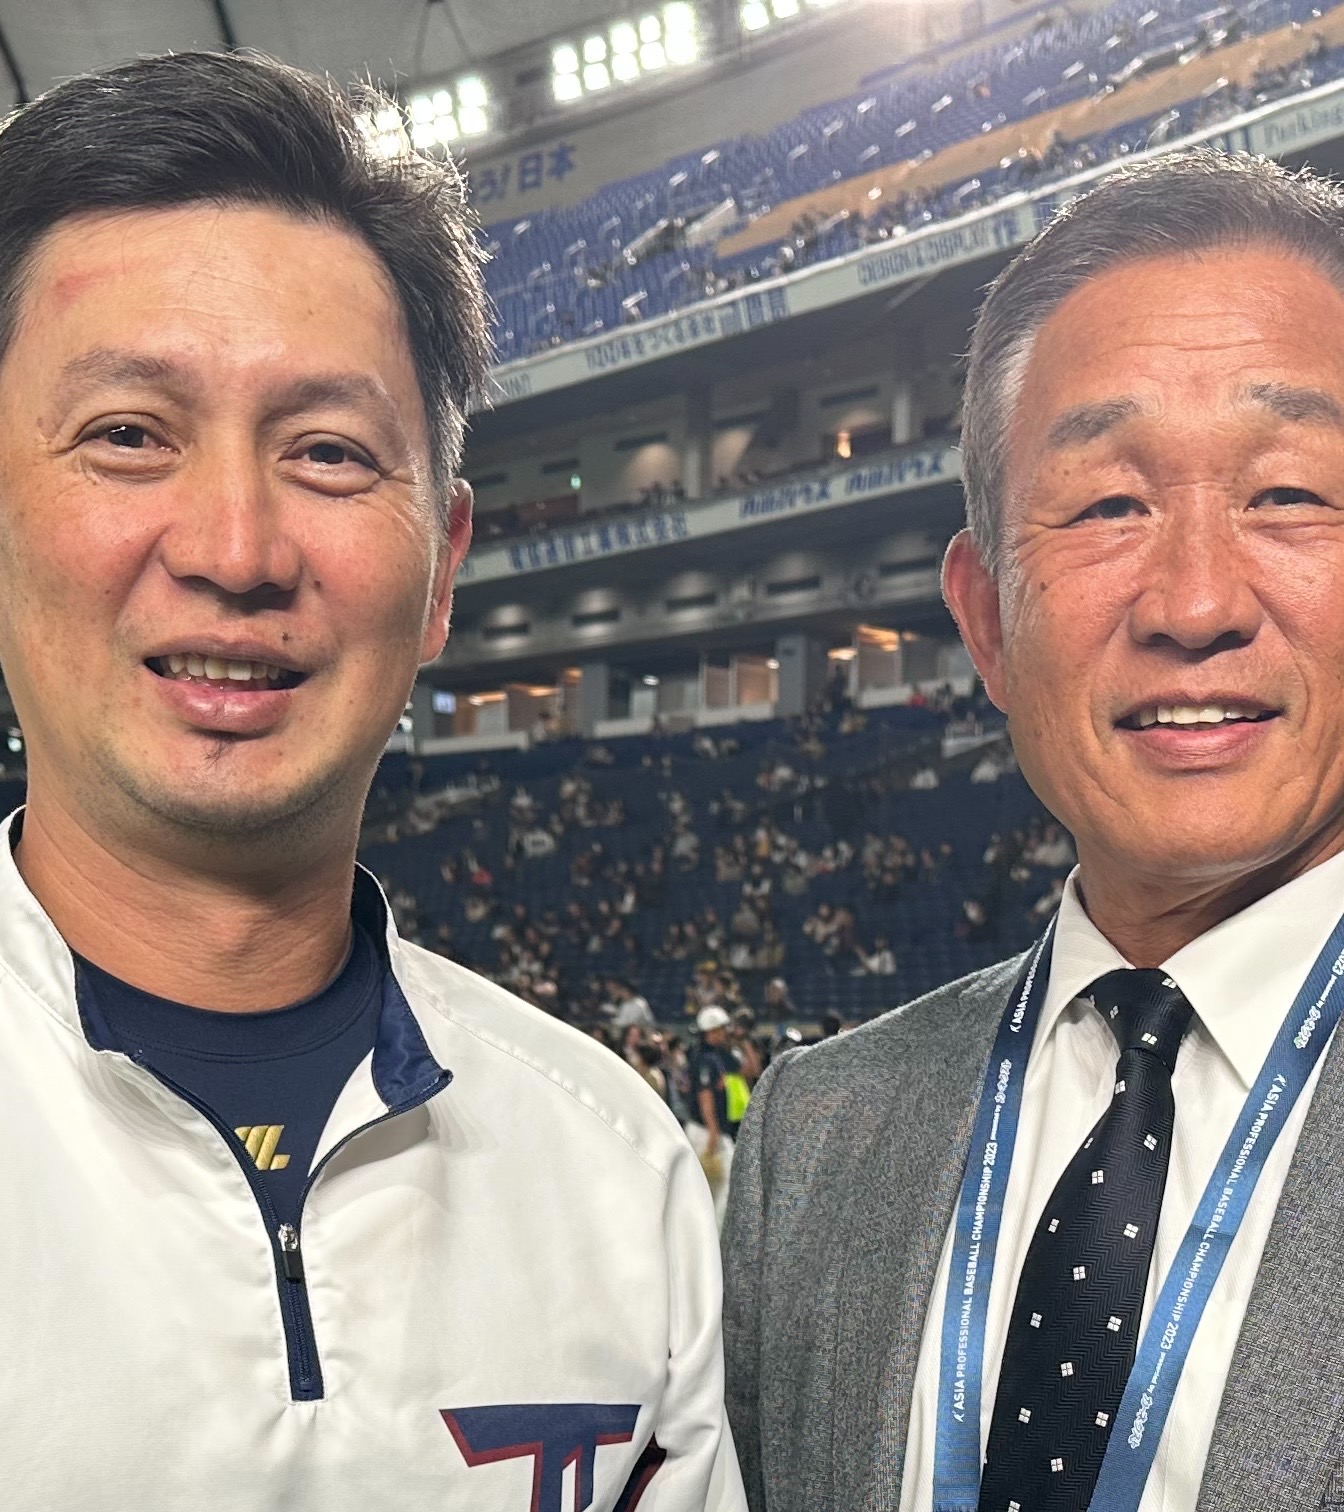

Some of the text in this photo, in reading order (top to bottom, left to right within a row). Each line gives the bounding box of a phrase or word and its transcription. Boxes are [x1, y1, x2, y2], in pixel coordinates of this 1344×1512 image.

[1260, 1083, 1282, 1112] ASIA
[983, 1141, 998, 1166] 2023
[1226, 1111, 1269, 1186] PROFESSIONAL
[971, 1166, 993, 1241] CHAMPIONSHIP
[1204, 1187, 1234, 1243] BASEBALL
[963, 1242, 981, 1296] BASEBALL
[1172, 1241, 1211, 1322] CHAMPIONSHIP
[956, 1296, 973, 1378] PROFESSIONAL
[1159, 1320, 1179, 1351] 2023
[953, 1382, 965, 1411] ASIA
